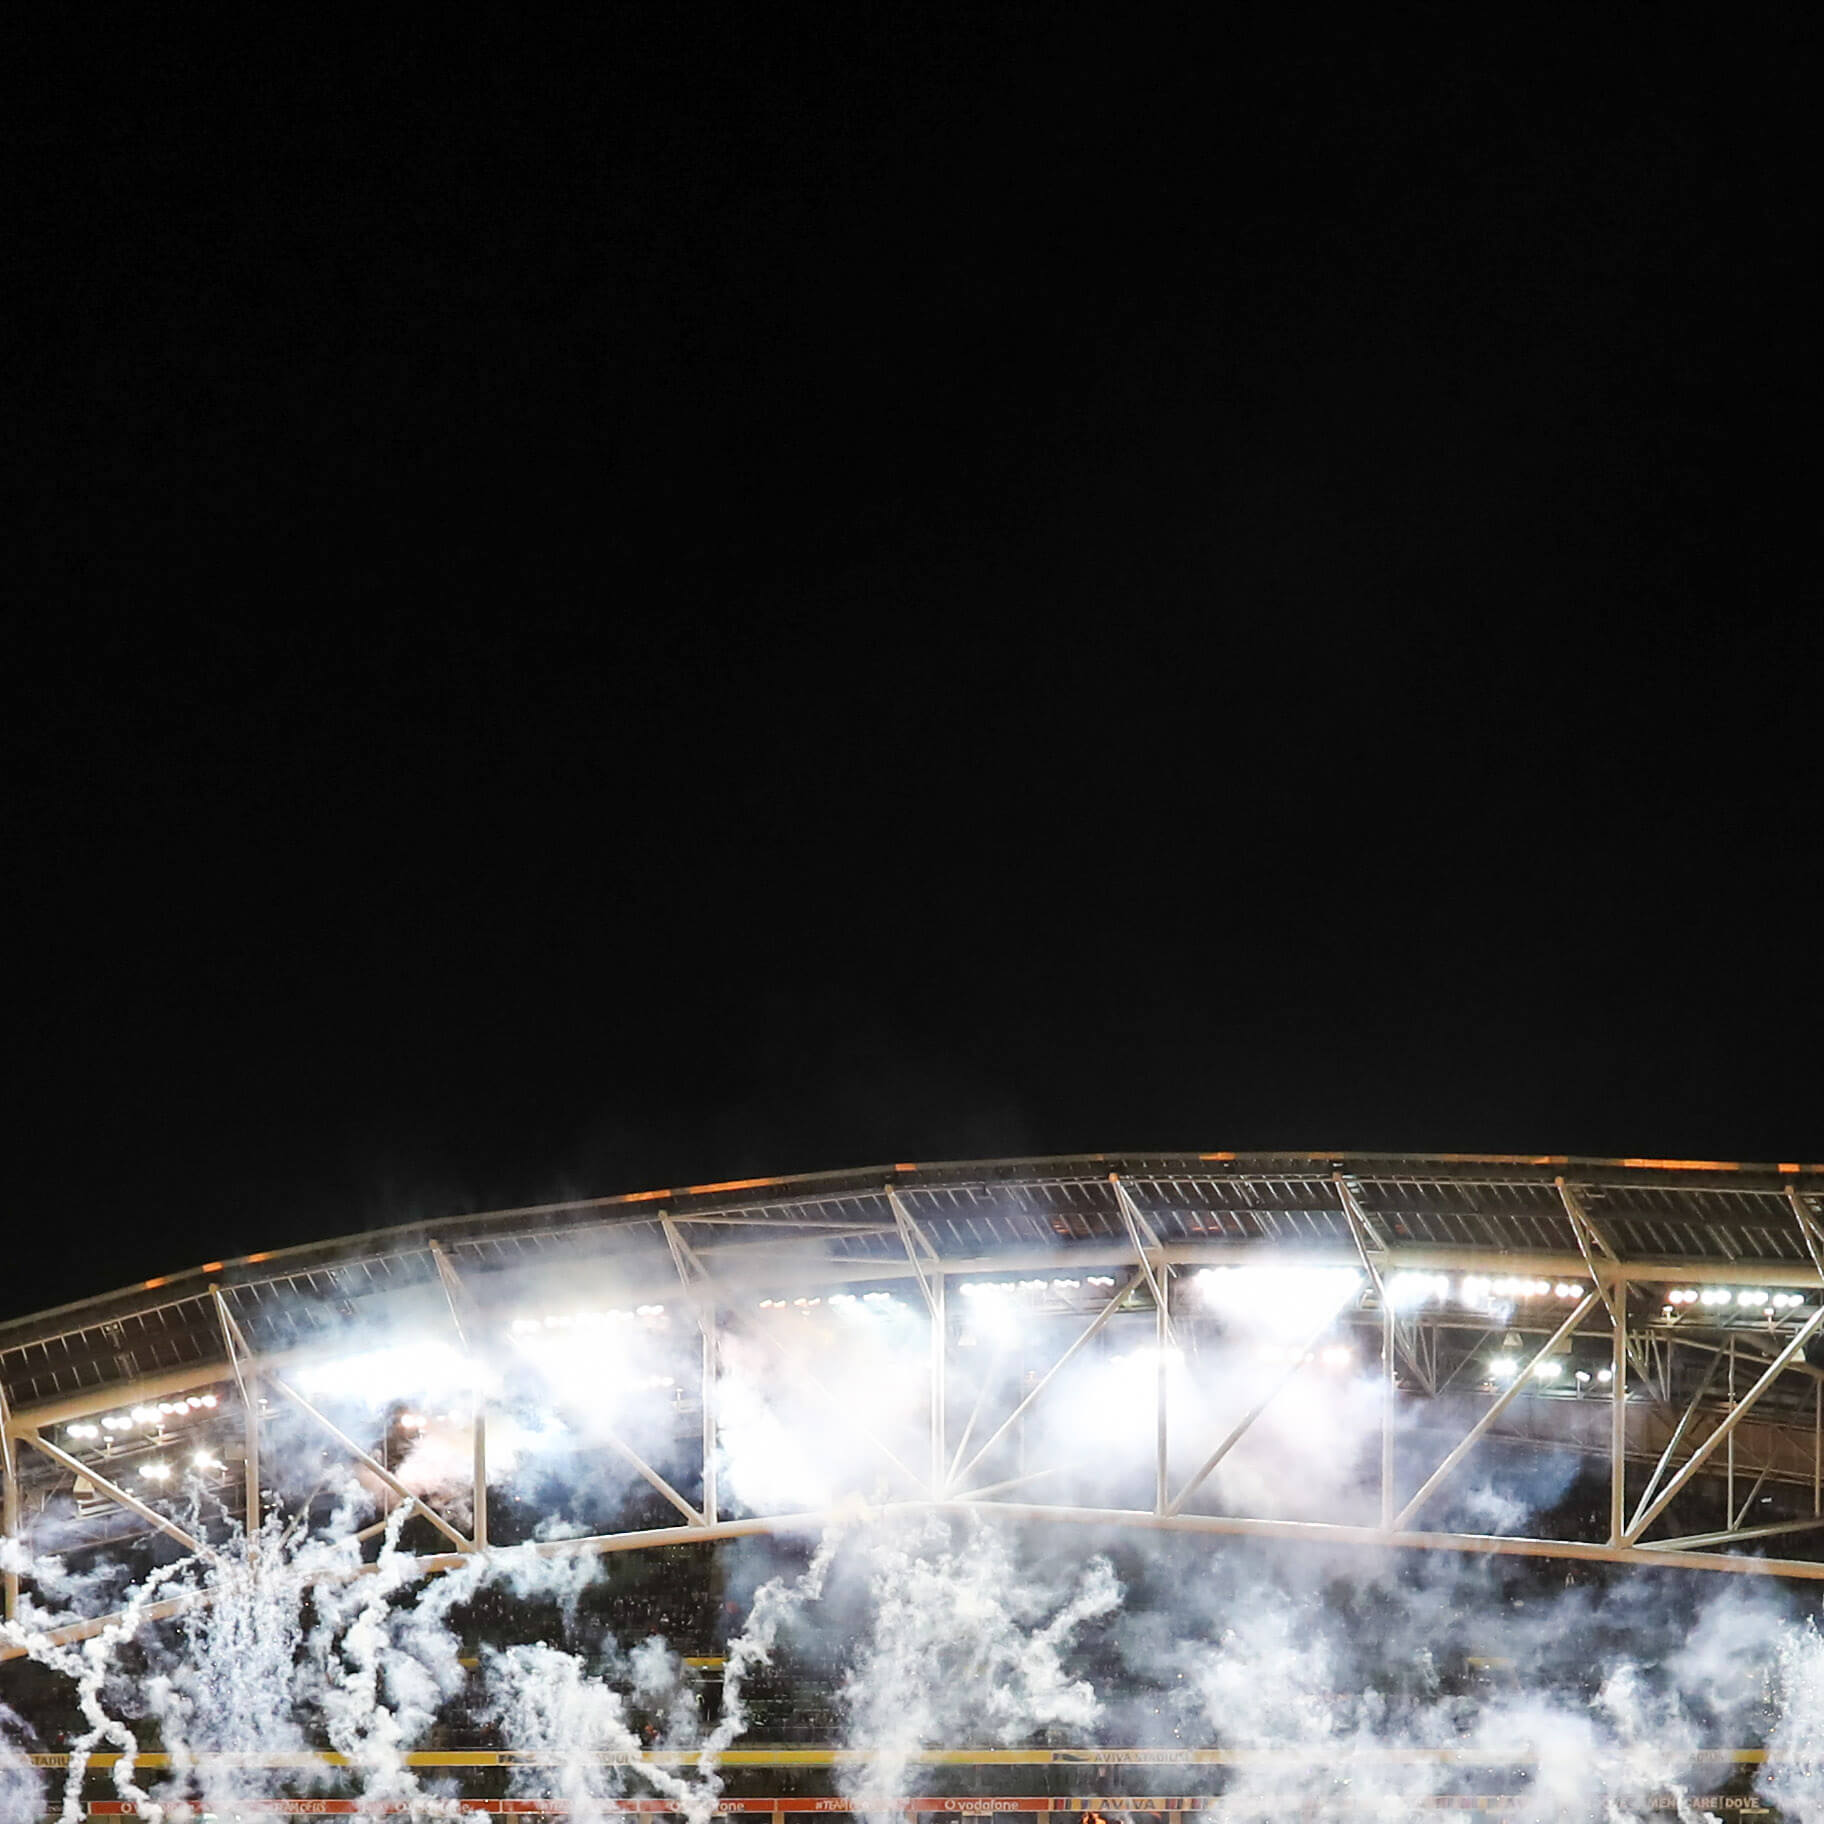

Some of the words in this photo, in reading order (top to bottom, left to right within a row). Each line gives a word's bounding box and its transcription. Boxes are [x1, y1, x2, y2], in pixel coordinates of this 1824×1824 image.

[957, 1799, 1018, 1811] vodafone
[1099, 1800, 1156, 1810] AVIVA
[1725, 1797, 1759, 1808] DOVE
